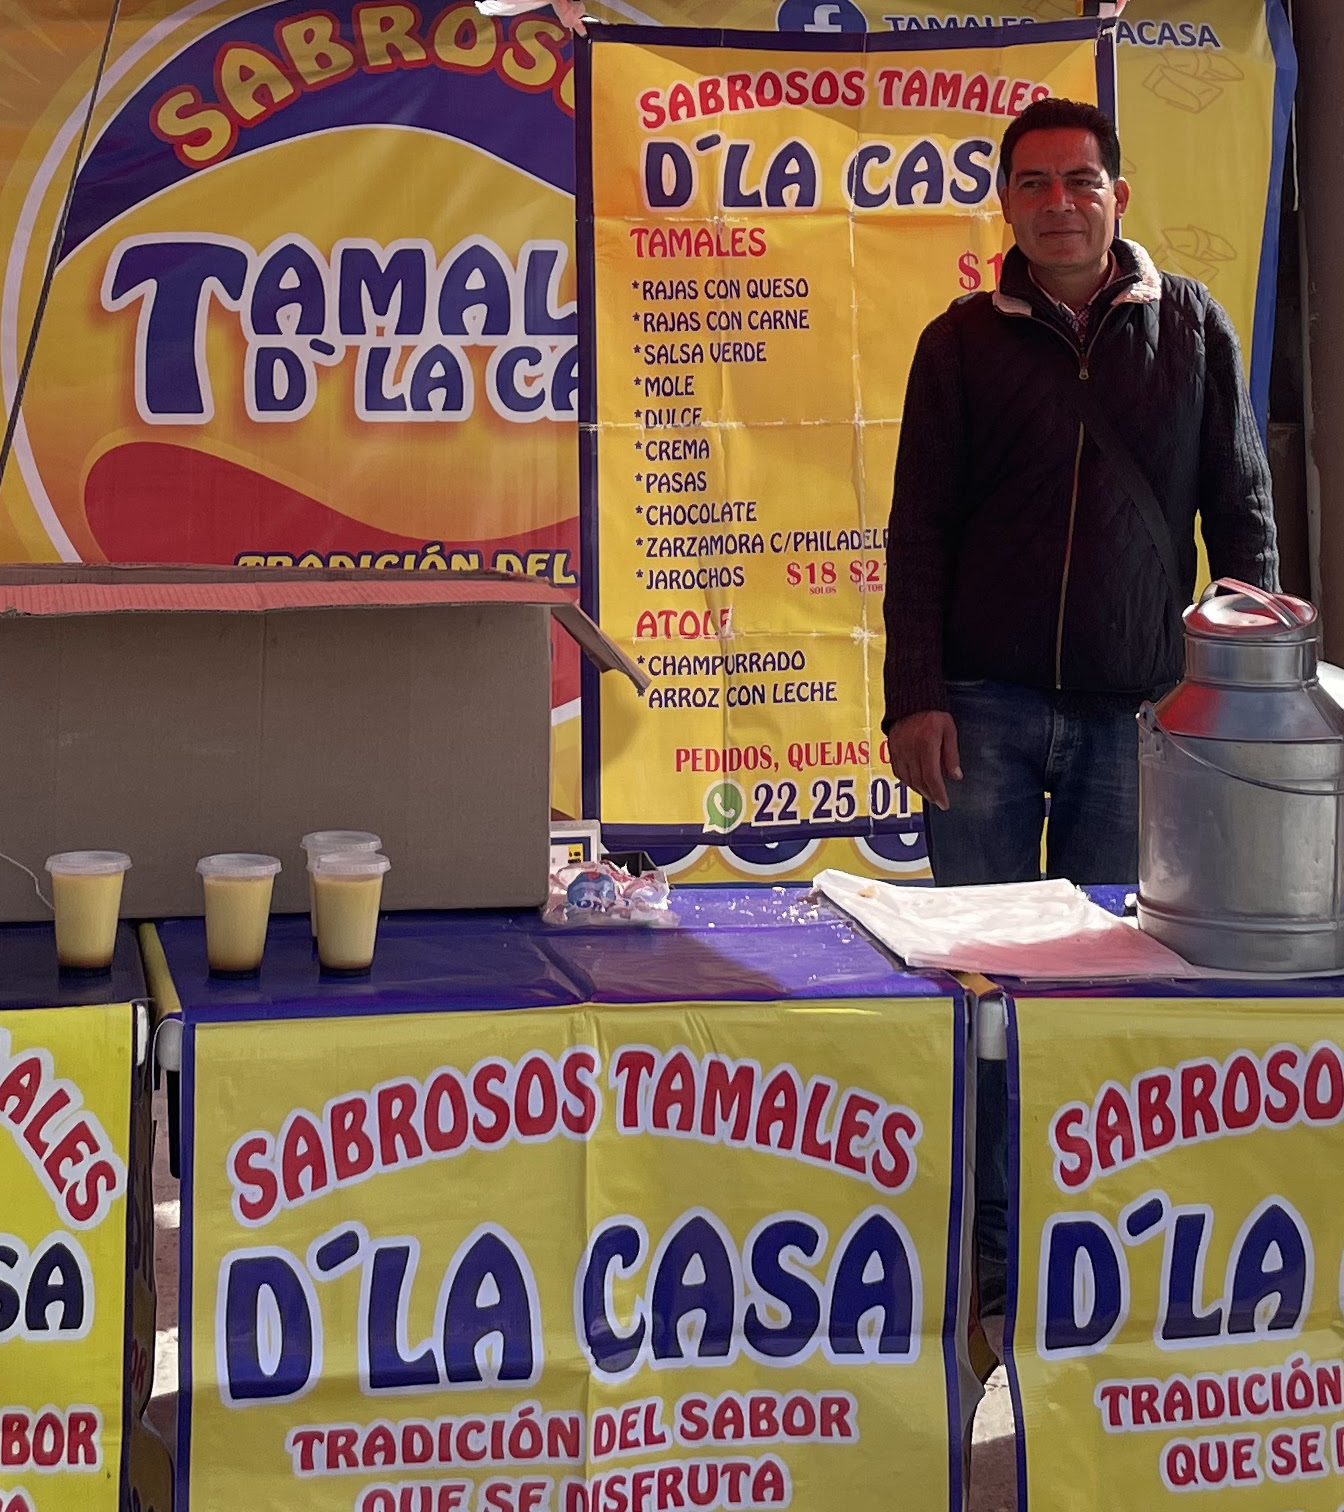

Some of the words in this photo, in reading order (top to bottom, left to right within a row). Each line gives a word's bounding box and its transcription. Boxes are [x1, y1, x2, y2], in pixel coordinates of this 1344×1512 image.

[1116, 21, 1220, 48] ACASA
[152, 2, 575, 167] SABROS
[640, 70, 864, 129] SABROSOS
[848, 140, 1005, 209] CAS
[630, 227, 767, 258] TAMALES
[704, 279, 741, 299] CON
[747, 278, 809, 299] QUESO
[958, 250, 1003, 292] $1
[112, 242, 578, 413] TAMAL
[707, 311, 743, 331] CON
[748, 309, 810, 330] CARNE
[709, 341, 767, 363] VERDE
[494, 344, 578, 412] CA
[770, 528, 890, 555] C/PHILADELP
[786, 561, 837, 586] $18
[849, 559, 887, 584] $2
[635, 608, 734, 640] ATOLE
[727, 684, 766, 707] CON
[773, 681, 837, 705] LECHE
[675, 744, 780, 774] PEDIDOS,
[788, 740, 870, 771] QUEJAS
[754, 782, 797, 823] 22
[812, 779, 856, 819] 25
[870, 778, 912, 816] 01
[234, 1052, 597, 1220] SABROSOS
[616, 1051, 917, 1188] TAMALES
[583, 1214, 914, 1372] CASA
[1101, 1358, 1342, 1428] TRADICIÓN
[292, 1407, 580, 1470] TRADICIÓN
[594, 1403, 667, 1455] DEL
[679, 1396, 853, 1440] SABOR
[1165, 1437, 1256, 1485] QUE
[1271, 1431, 1324, 1475] SE
[566, 1460, 784, 1512] DISFRUTA
